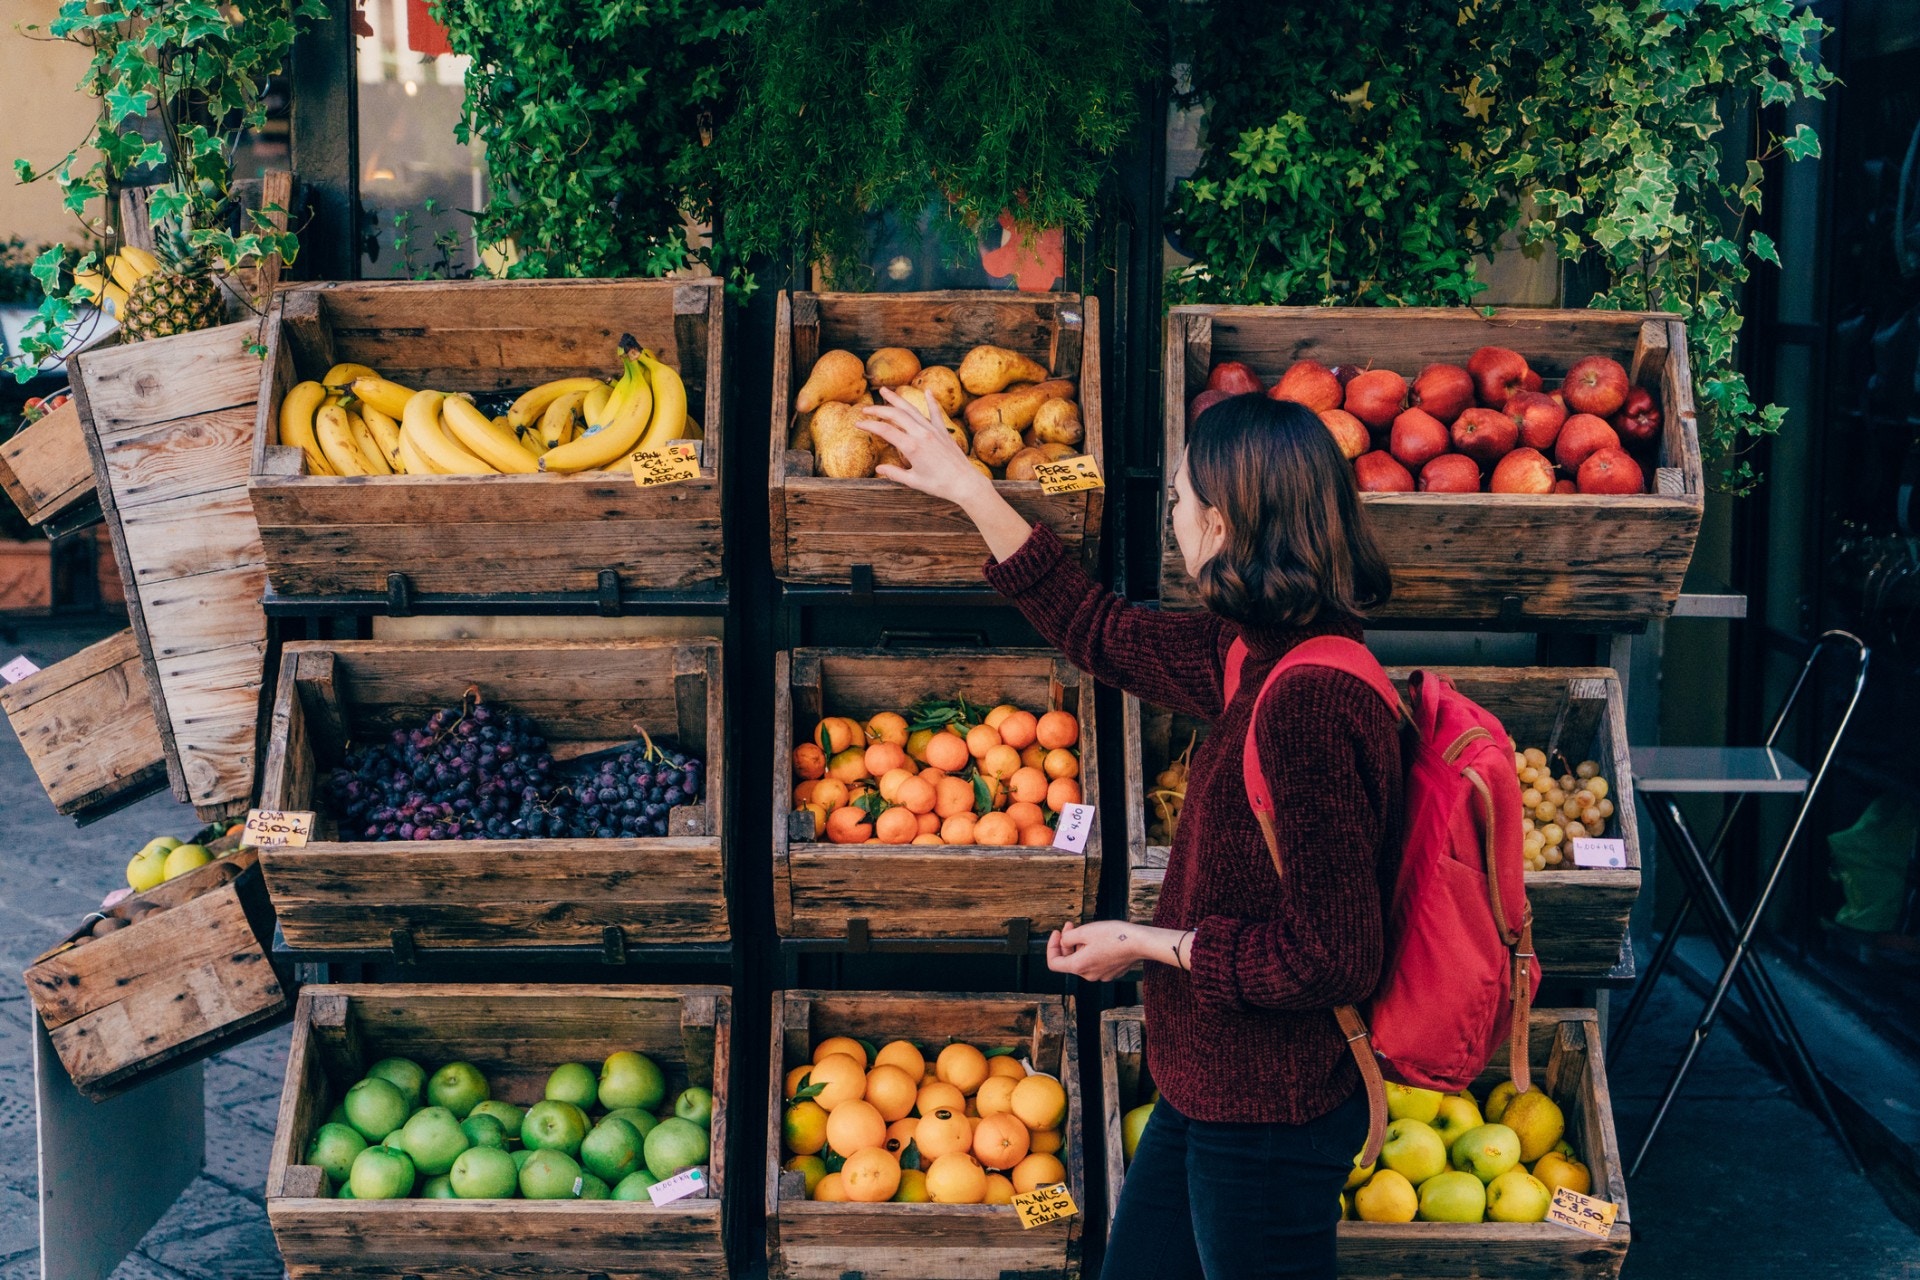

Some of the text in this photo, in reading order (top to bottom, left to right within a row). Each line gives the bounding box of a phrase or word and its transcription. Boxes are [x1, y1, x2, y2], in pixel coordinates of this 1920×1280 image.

[1035, 465, 1071, 475] PERE
[259, 811, 285, 821] UVA
[1557, 1188, 1590, 1206] MELE
